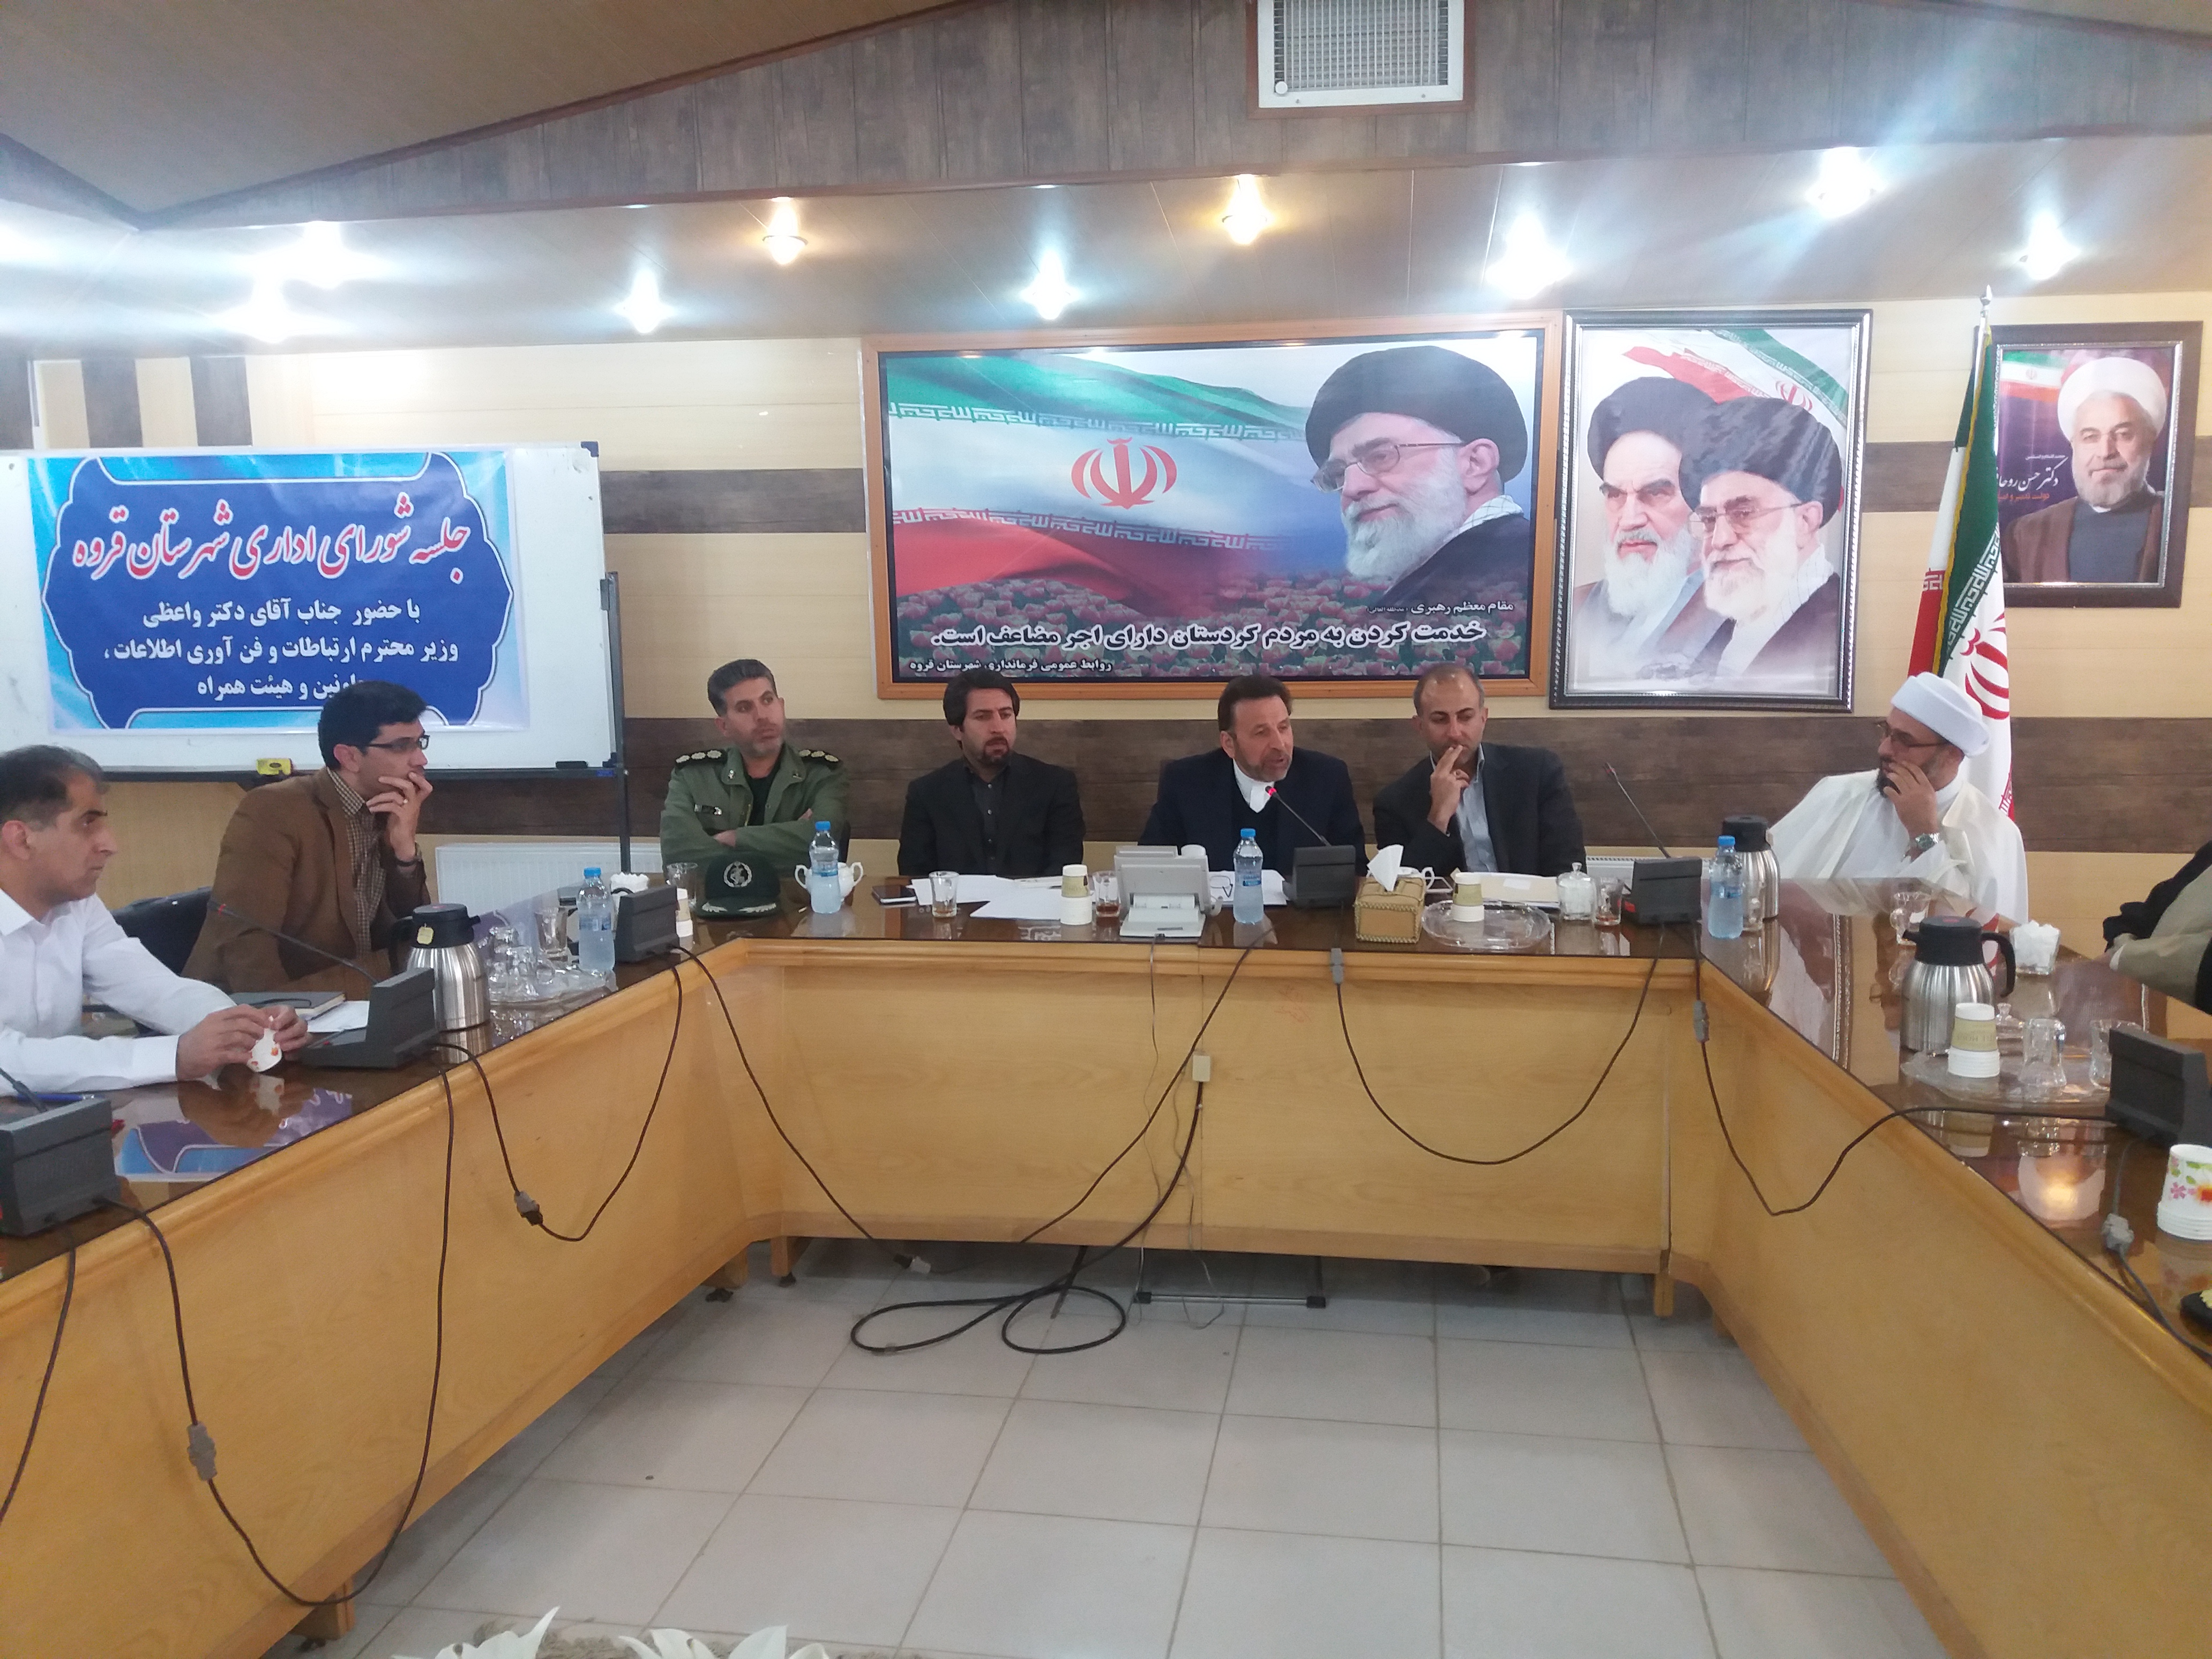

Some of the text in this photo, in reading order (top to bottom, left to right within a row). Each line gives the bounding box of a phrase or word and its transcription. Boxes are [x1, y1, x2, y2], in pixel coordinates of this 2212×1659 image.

[2018, 472, 2040, 491] حسن
[73, 492, 470, 584] جلسه شورای اداری شهرستان قروه
[143, 597, 420, 627] با حضور جناب آقای دکتر واعظی
[1411, 603, 1451, 615] رهبری
[1453, 601, 1486, 615] معظم
[1488, 601, 1514, 614] مقام
[987, 625, 1061, 646] مضاعف
[1062, 624, 1103, 651] اجر
[1105, 623, 1168, 651] دارای
[1169, 623, 1262, 650] کردستان
[1262, 626, 1320, 650] مردم
[1321, 625, 1346, 648] به
[1346, 621, 1411, 648] کردن
[1411, 620, 1486, 643] خدمت
[187, 636, 233, 664] آوری
[240, 636, 263, 664] فن
[268, 646, 277, 664] و
[282, 636, 356, 663] ارتباطات
[361, 639, 415, 662] محترم
[420, 639, 458, 662] وزیر
[910, 659, 934, 672] قروه
[936, 659, 982, 672] شهرستان
[1040, 661, 1077, 672] عمومی
[1080, 659, 1112, 672] روابط
[198, 675, 246, 701] همراه
[250, 675, 293, 699] هیئت
[298, 682, 308, 700] و
